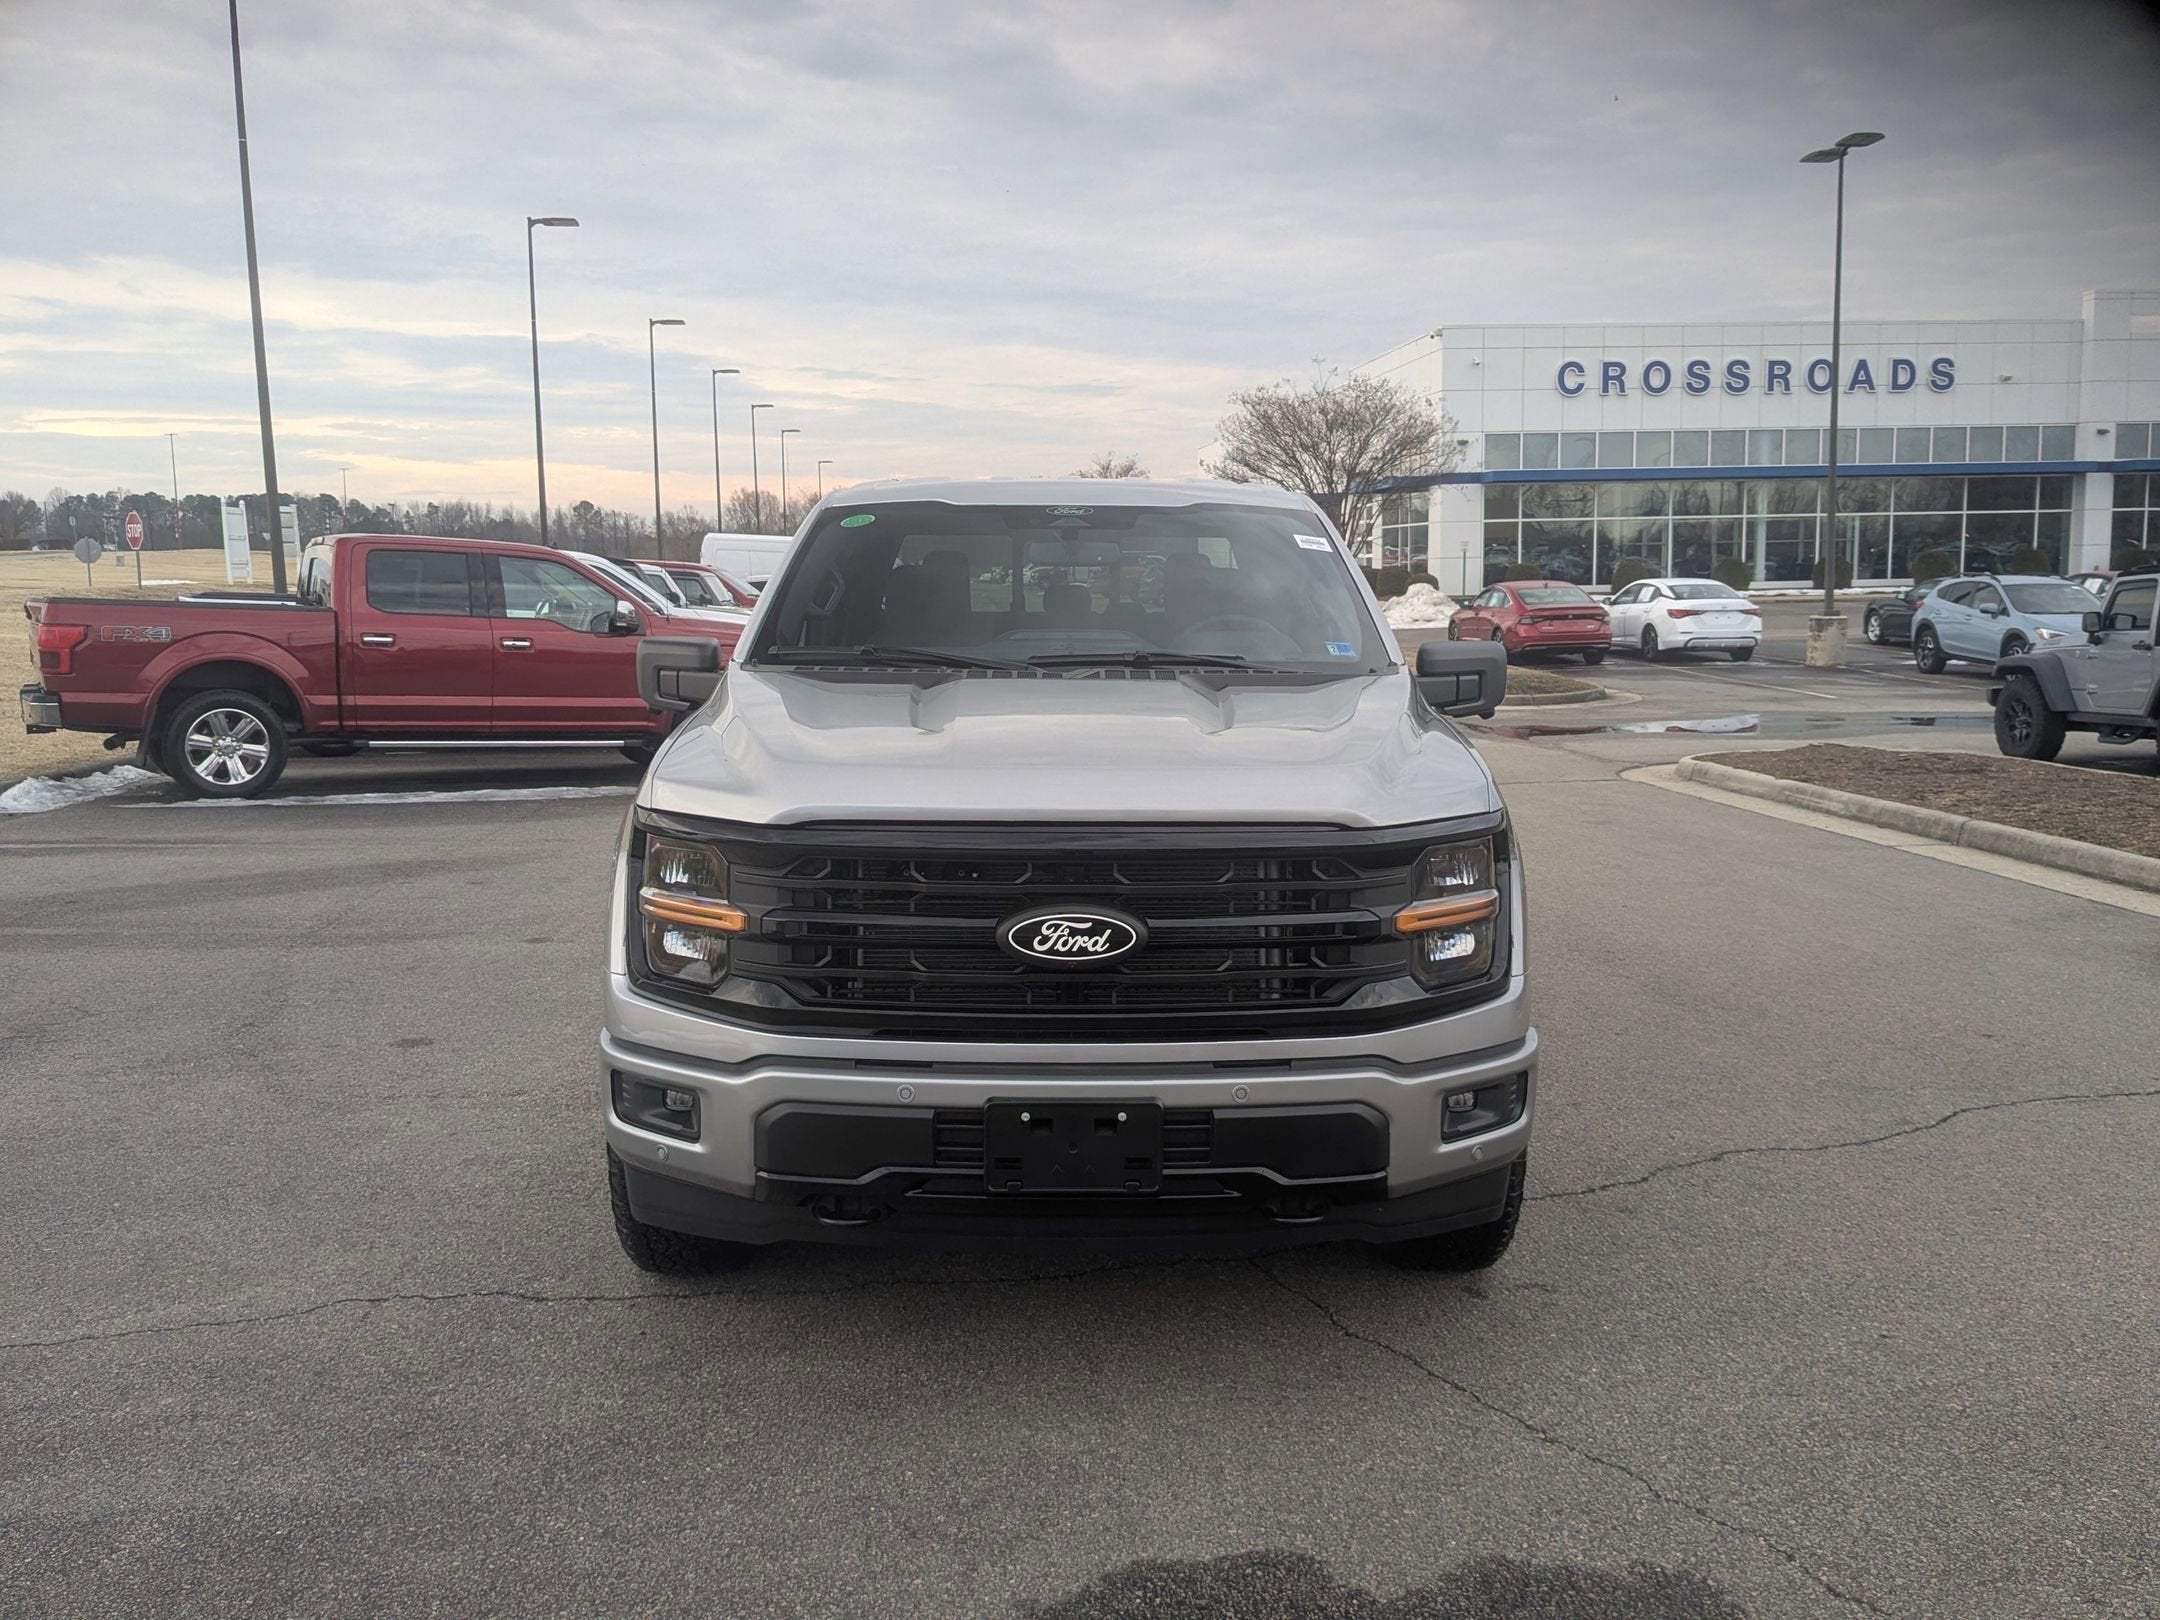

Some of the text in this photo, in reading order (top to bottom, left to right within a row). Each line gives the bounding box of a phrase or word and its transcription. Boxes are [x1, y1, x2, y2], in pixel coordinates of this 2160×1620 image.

[1557, 358, 1956, 397] CROSSROADS
[1054, 506, 1086, 515] Ford
[127, 523, 141, 538] STOP
[101, 626, 171, 641] FX4
[1033, 919, 1112, 952] Ford
